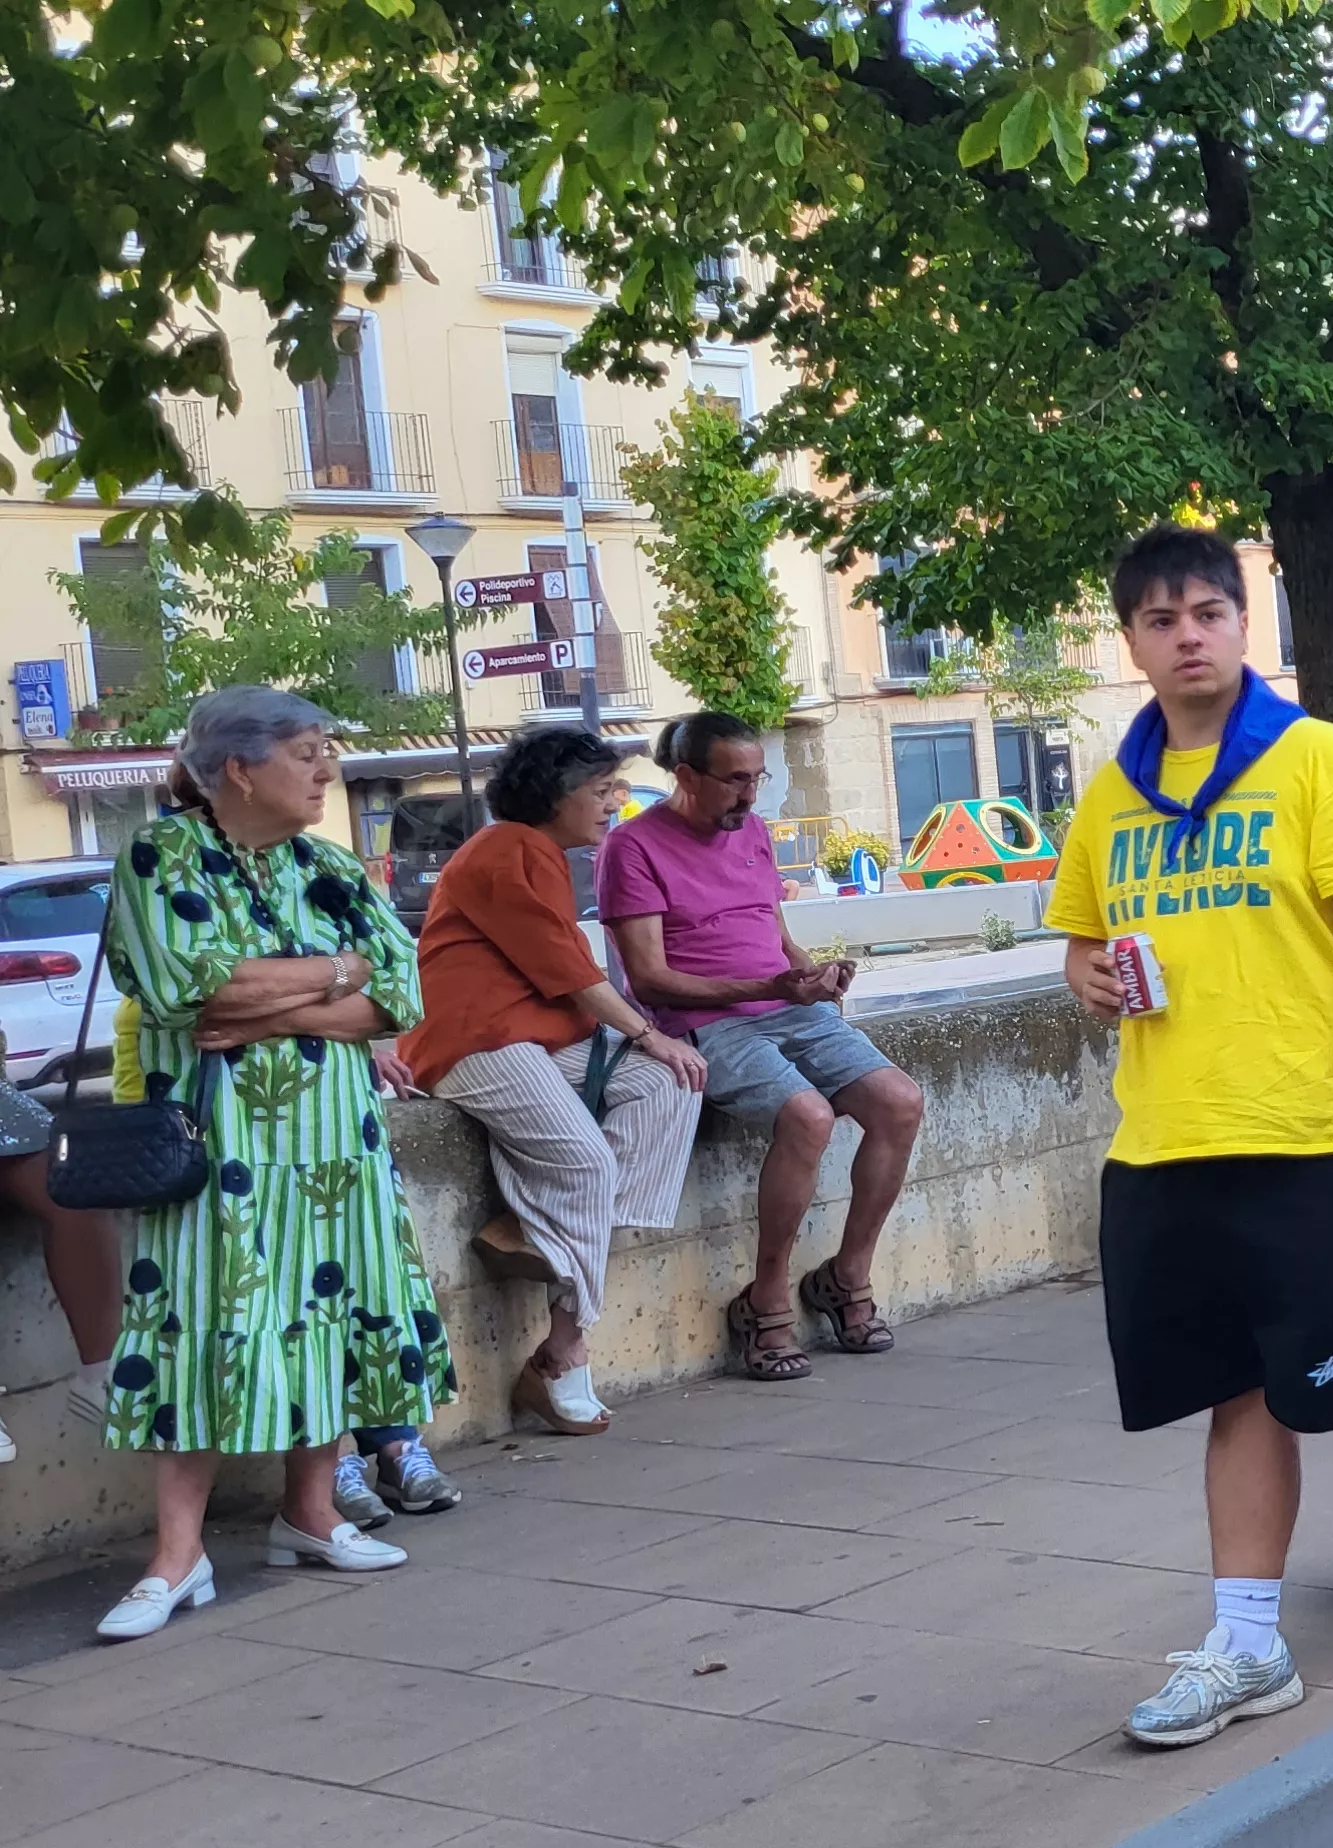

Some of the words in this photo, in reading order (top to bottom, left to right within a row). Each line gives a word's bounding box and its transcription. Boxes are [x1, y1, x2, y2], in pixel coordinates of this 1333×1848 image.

[479, 577, 536, 592] Polideportivo
[481, 593, 512, 604] Piscina
[489, 652, 546, 669] Aparcamiento
[555, 644, 568, 664] P
[58, 769, 151, 787] PELUQUERIA
[1119, 880, 1174, 896] SANTA
[1183, 869, 1246, 888] LETICIA
[1117, 948, 1145, 1009] AMBAR
